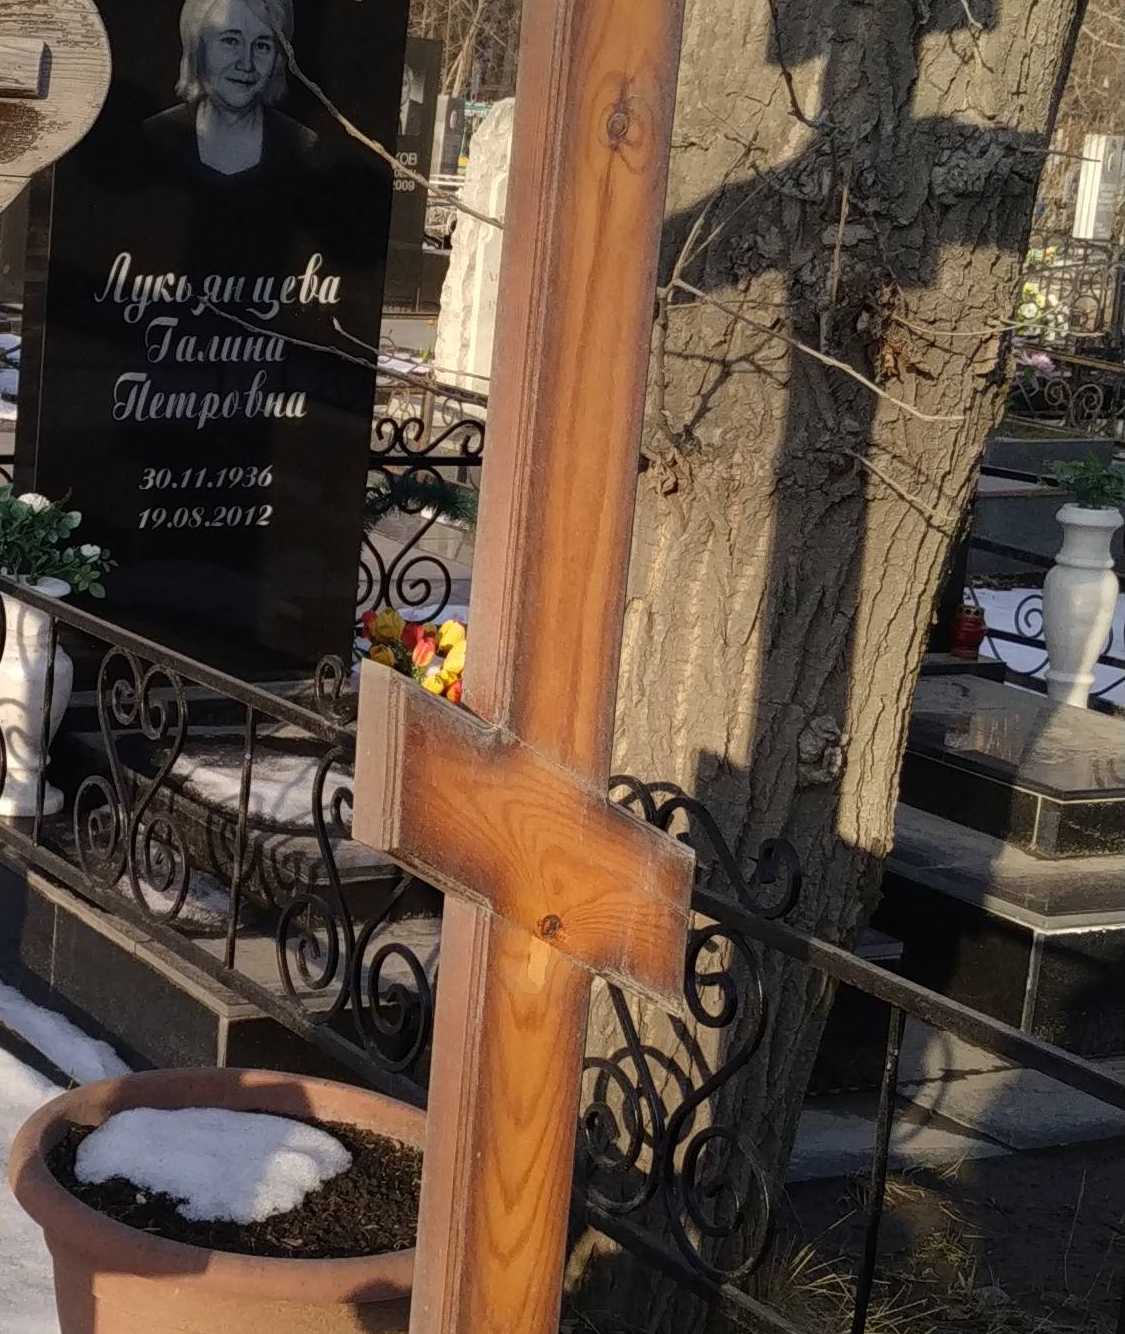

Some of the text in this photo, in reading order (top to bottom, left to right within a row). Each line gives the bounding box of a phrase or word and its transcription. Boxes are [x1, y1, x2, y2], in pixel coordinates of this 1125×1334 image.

[93, 251, 342, 324] Лукьянцева
[144, 316, 287, 363] Галина
[111, 369, 308, 430] Петровна
[138, 464, 275, 490] 30.11.1936
[138, 504, 274, 530] 19.08.2012
